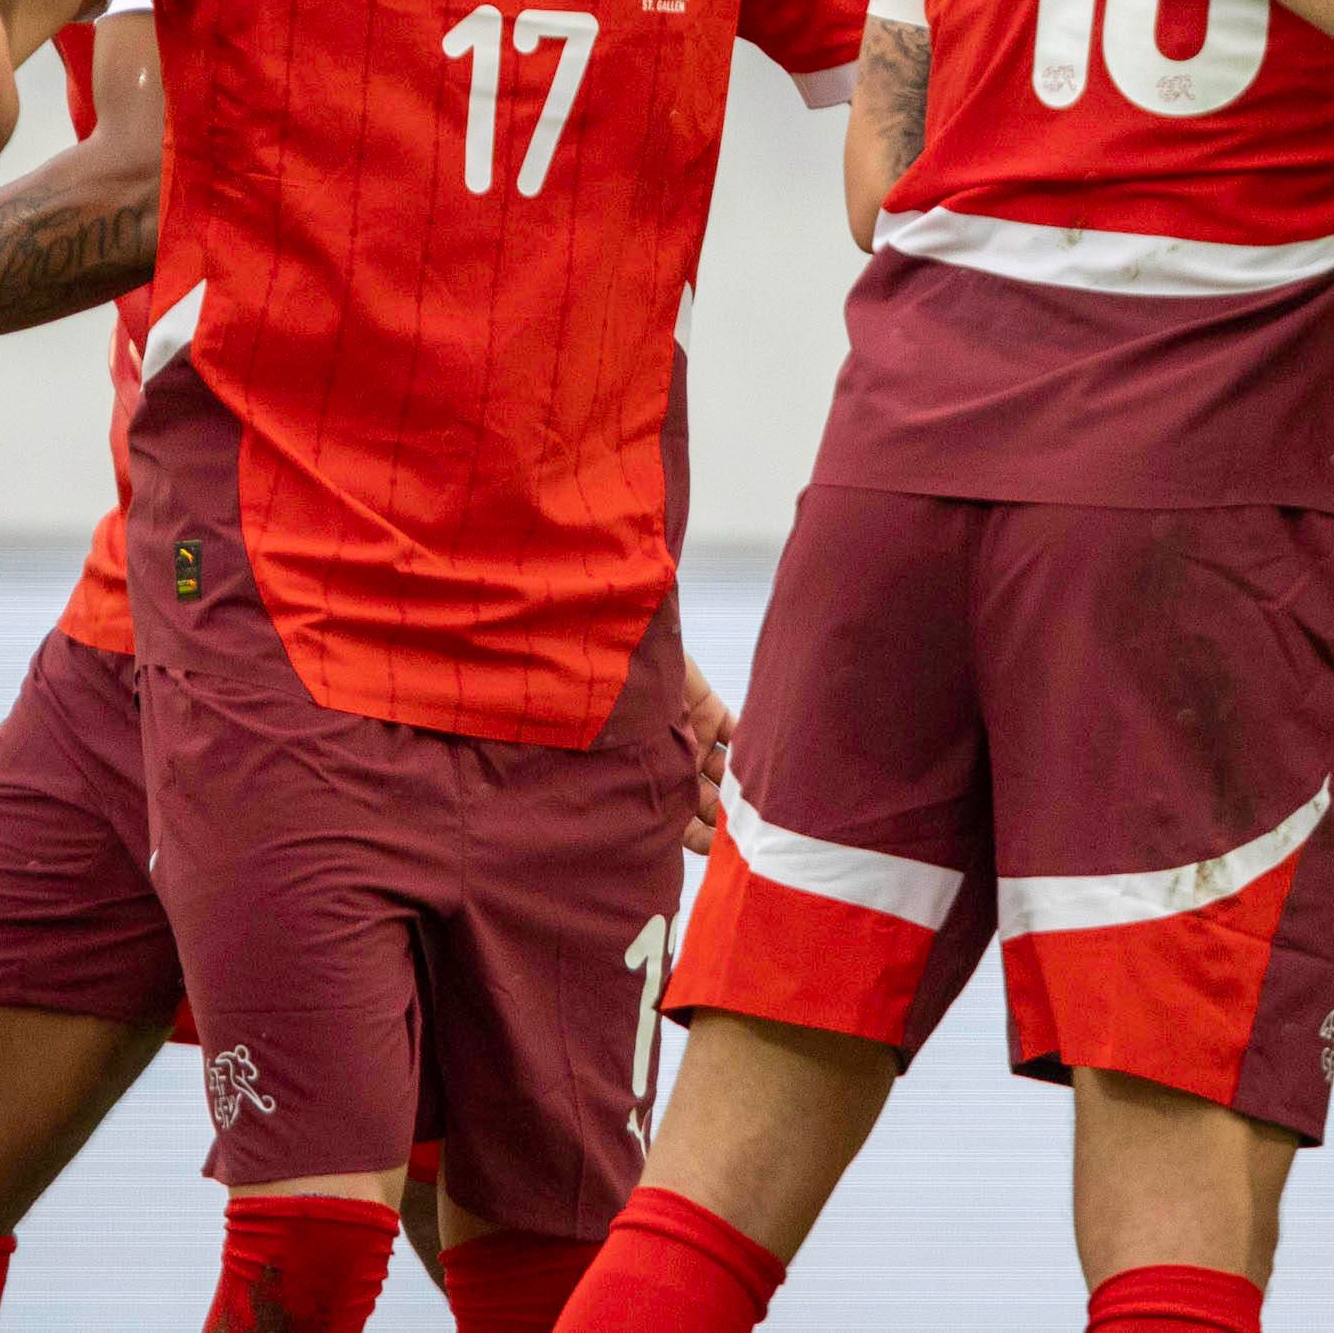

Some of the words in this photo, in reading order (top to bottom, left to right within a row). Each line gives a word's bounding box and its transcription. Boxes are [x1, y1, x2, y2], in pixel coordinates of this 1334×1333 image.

[656, 0, 685, 13] GALLEN
[441, 4, 600, 197] 17
[624, 914, 678, 1098] 1
